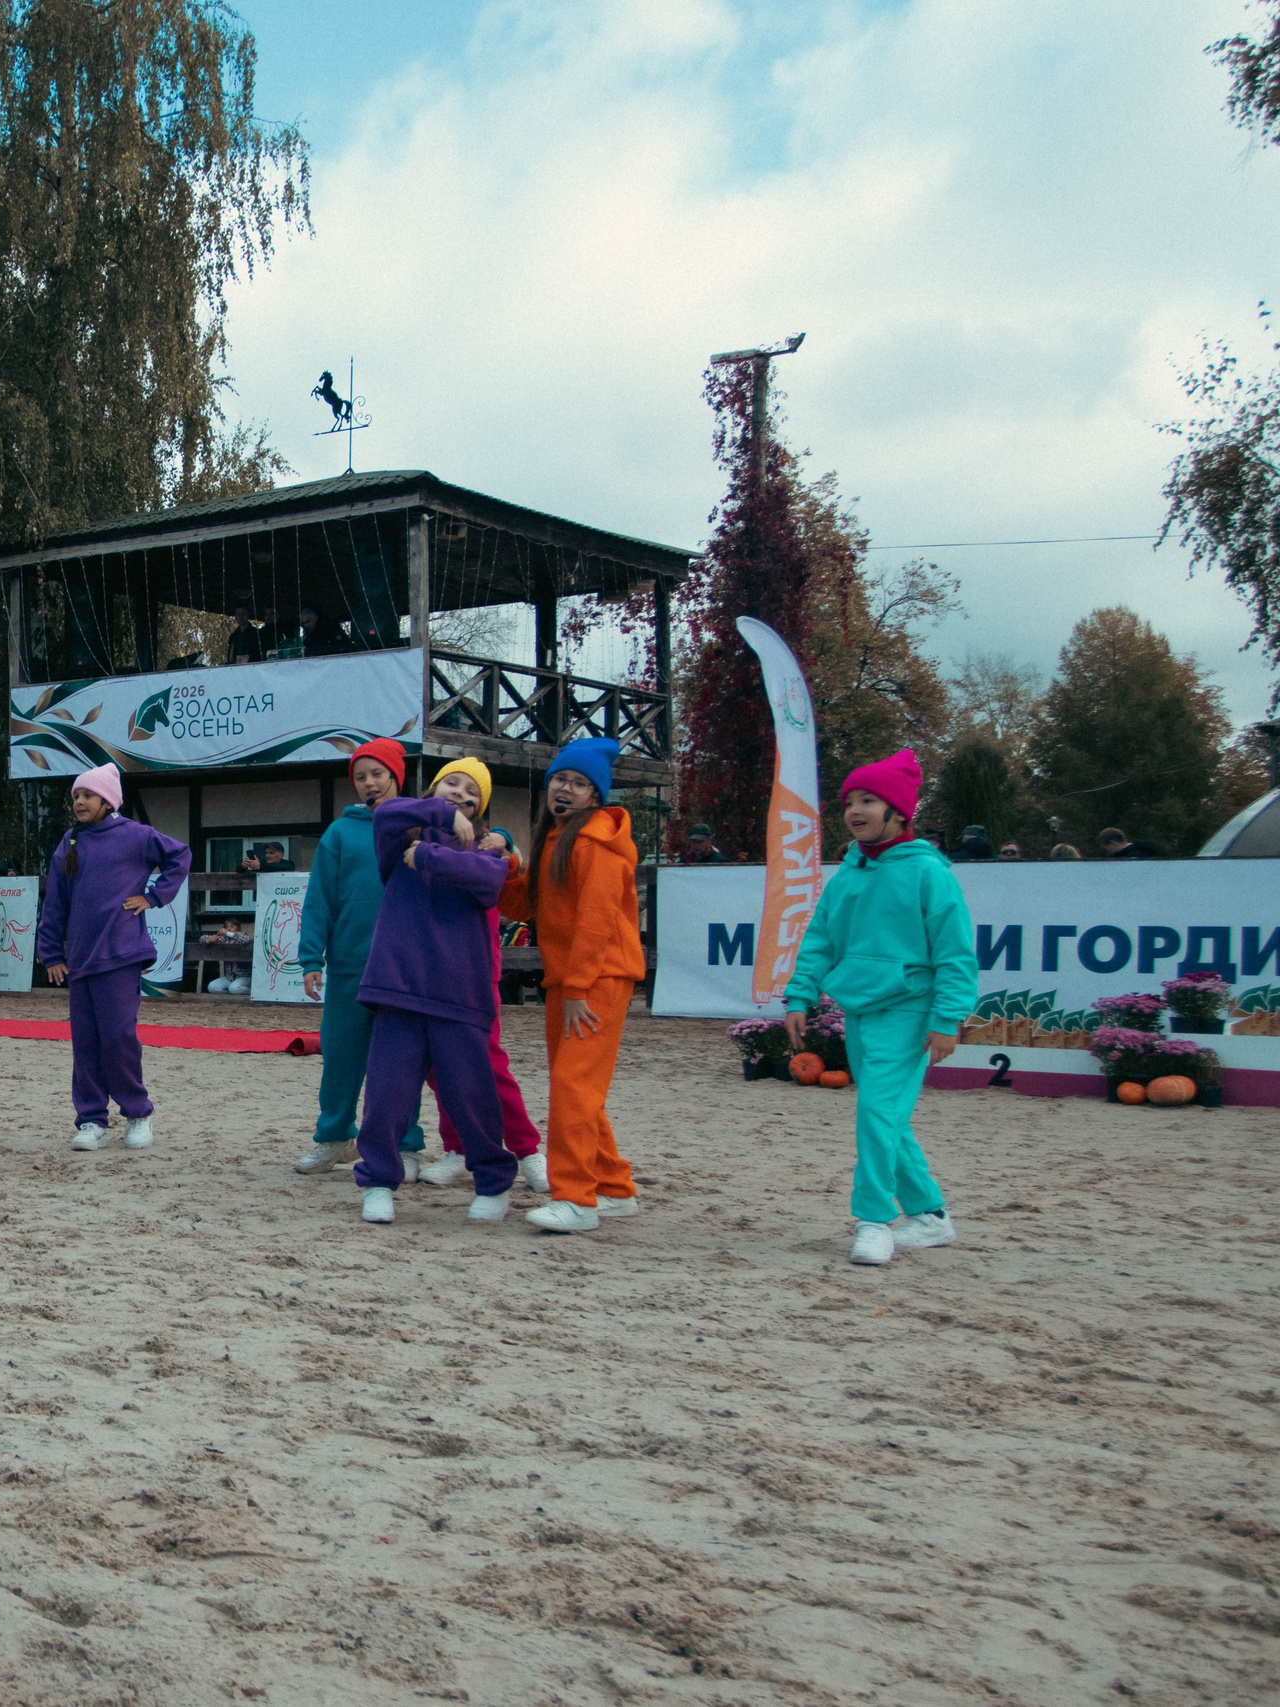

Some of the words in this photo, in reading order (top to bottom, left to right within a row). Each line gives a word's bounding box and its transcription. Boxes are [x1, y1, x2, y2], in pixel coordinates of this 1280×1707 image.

[173, 685, 205, 699] 2026
[173, 693, 274, 719] ЗОЛОТАЯ
[171, 717, 244, 739] ОСЕНЬ
[275, 887, 299, 895] СШОР
[146, 926, 172, 935] ОТАЯ
[988, 1053, 1013, 1087] 2
